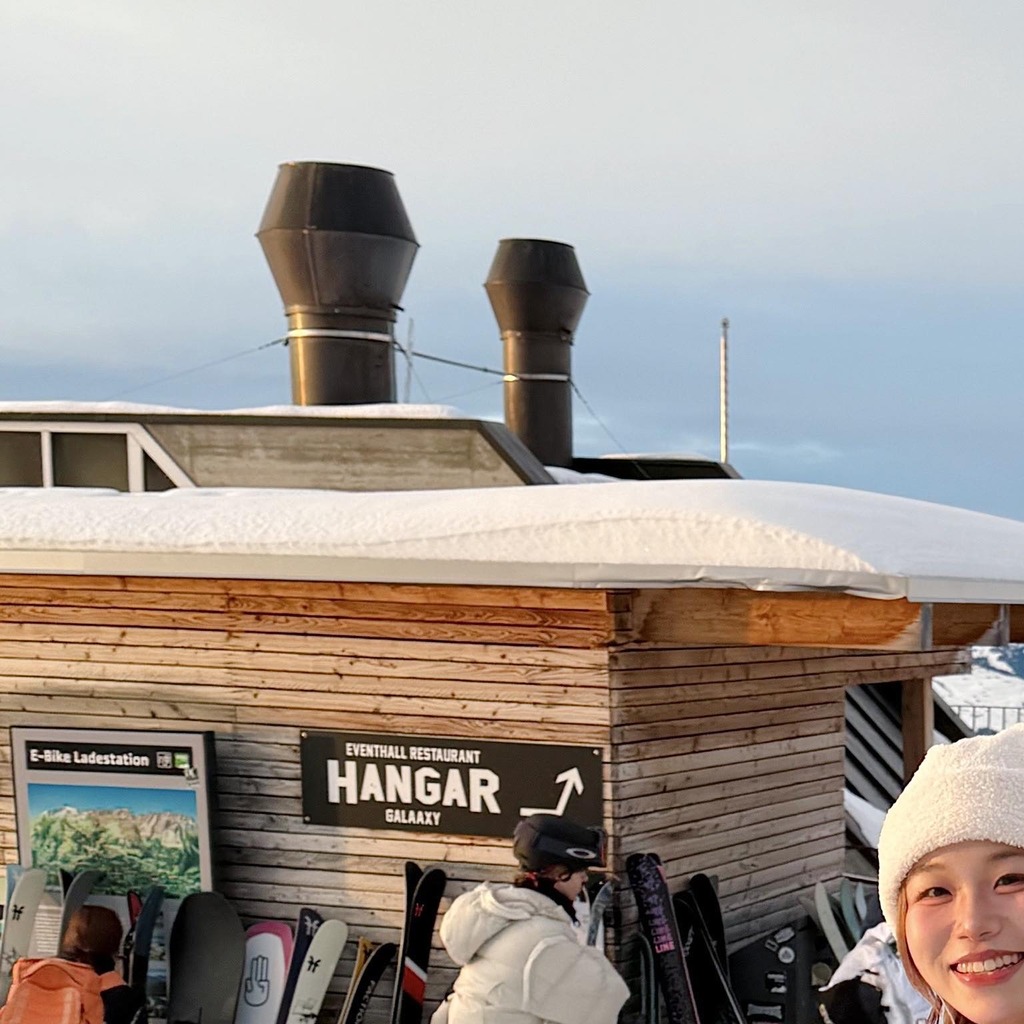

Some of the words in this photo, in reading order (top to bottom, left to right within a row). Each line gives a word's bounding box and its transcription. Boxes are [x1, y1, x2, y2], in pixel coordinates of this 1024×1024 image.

[29, 749, 71, 763] E-Bike
[73, 750, 150, 767] Ladestation
[345, 743, 407, 760] EVENTHALL
[409, 746, 481, 764] RESTAURANT
[327, 759, 501, 814] HANGAR
[385, 809, 441, 825] GALAAXY
